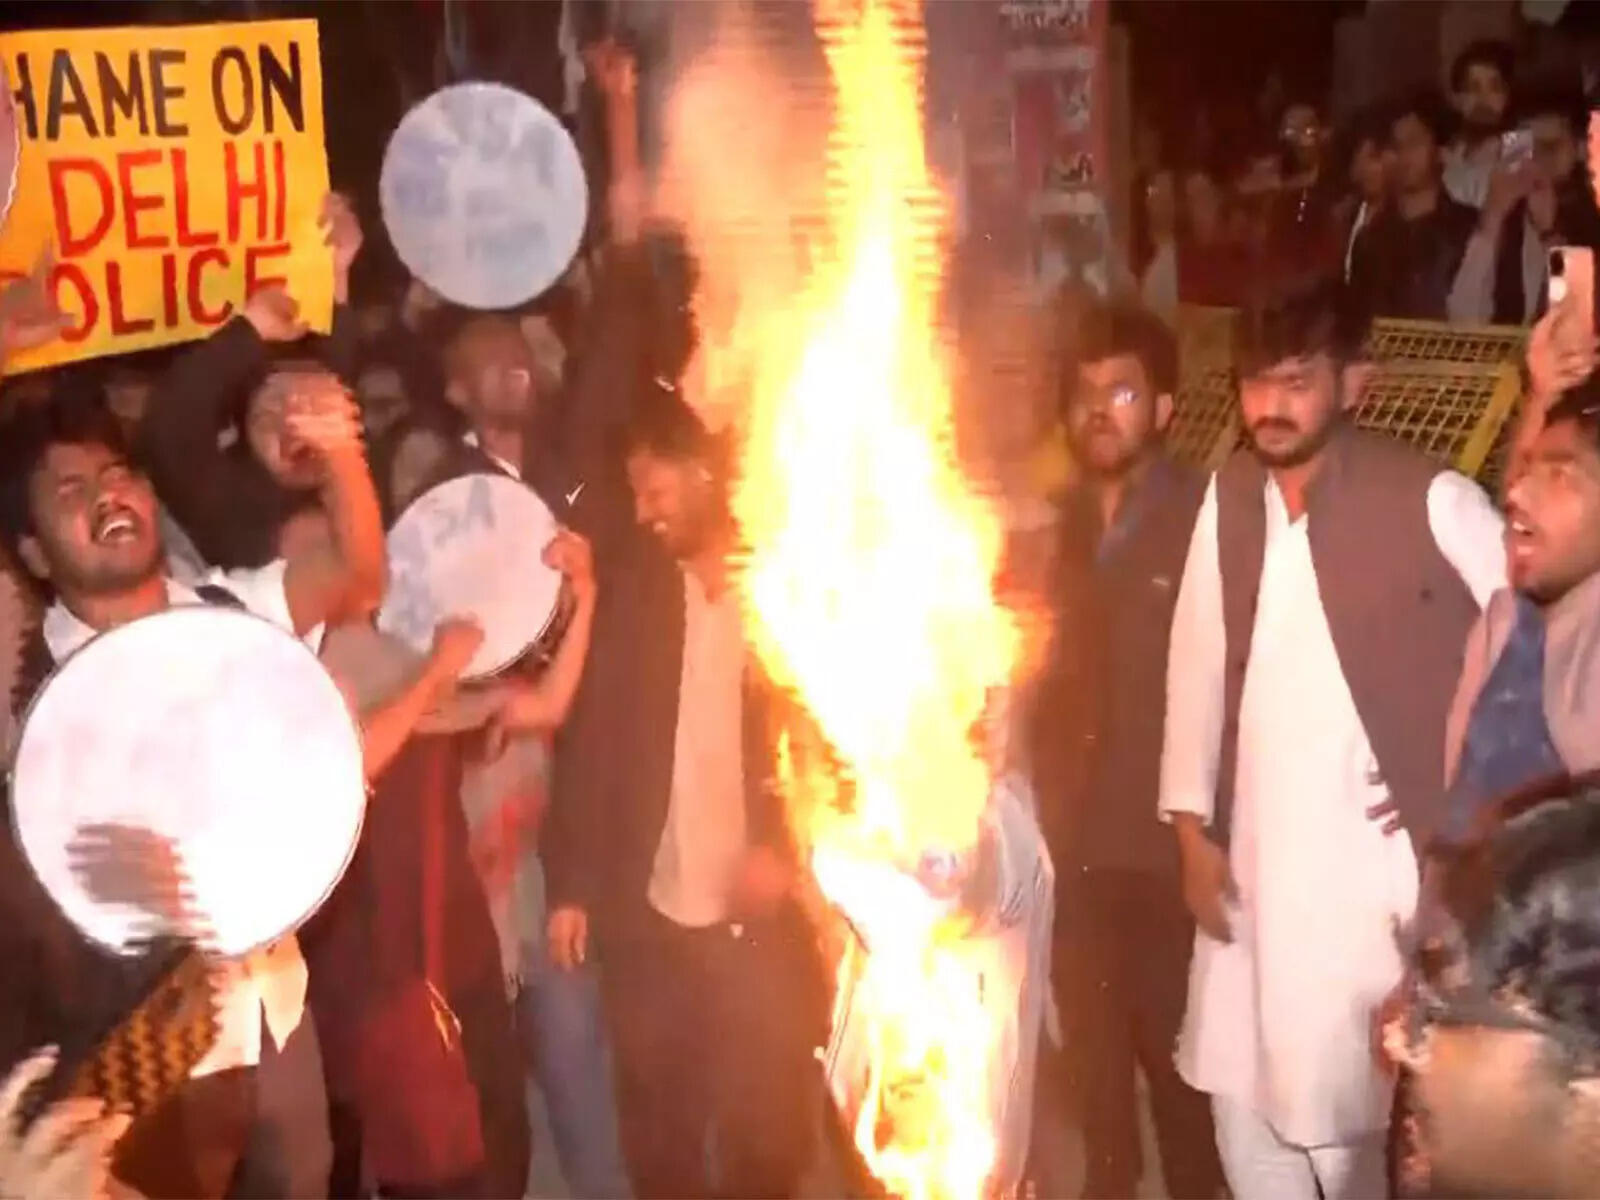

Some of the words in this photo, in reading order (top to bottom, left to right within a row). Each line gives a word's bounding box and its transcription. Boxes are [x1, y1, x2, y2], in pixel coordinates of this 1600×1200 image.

[211, 41, 304, 135] ON
[48, 140, 286, 257] DELHI
[0, 243, 291, 342] OLICE
